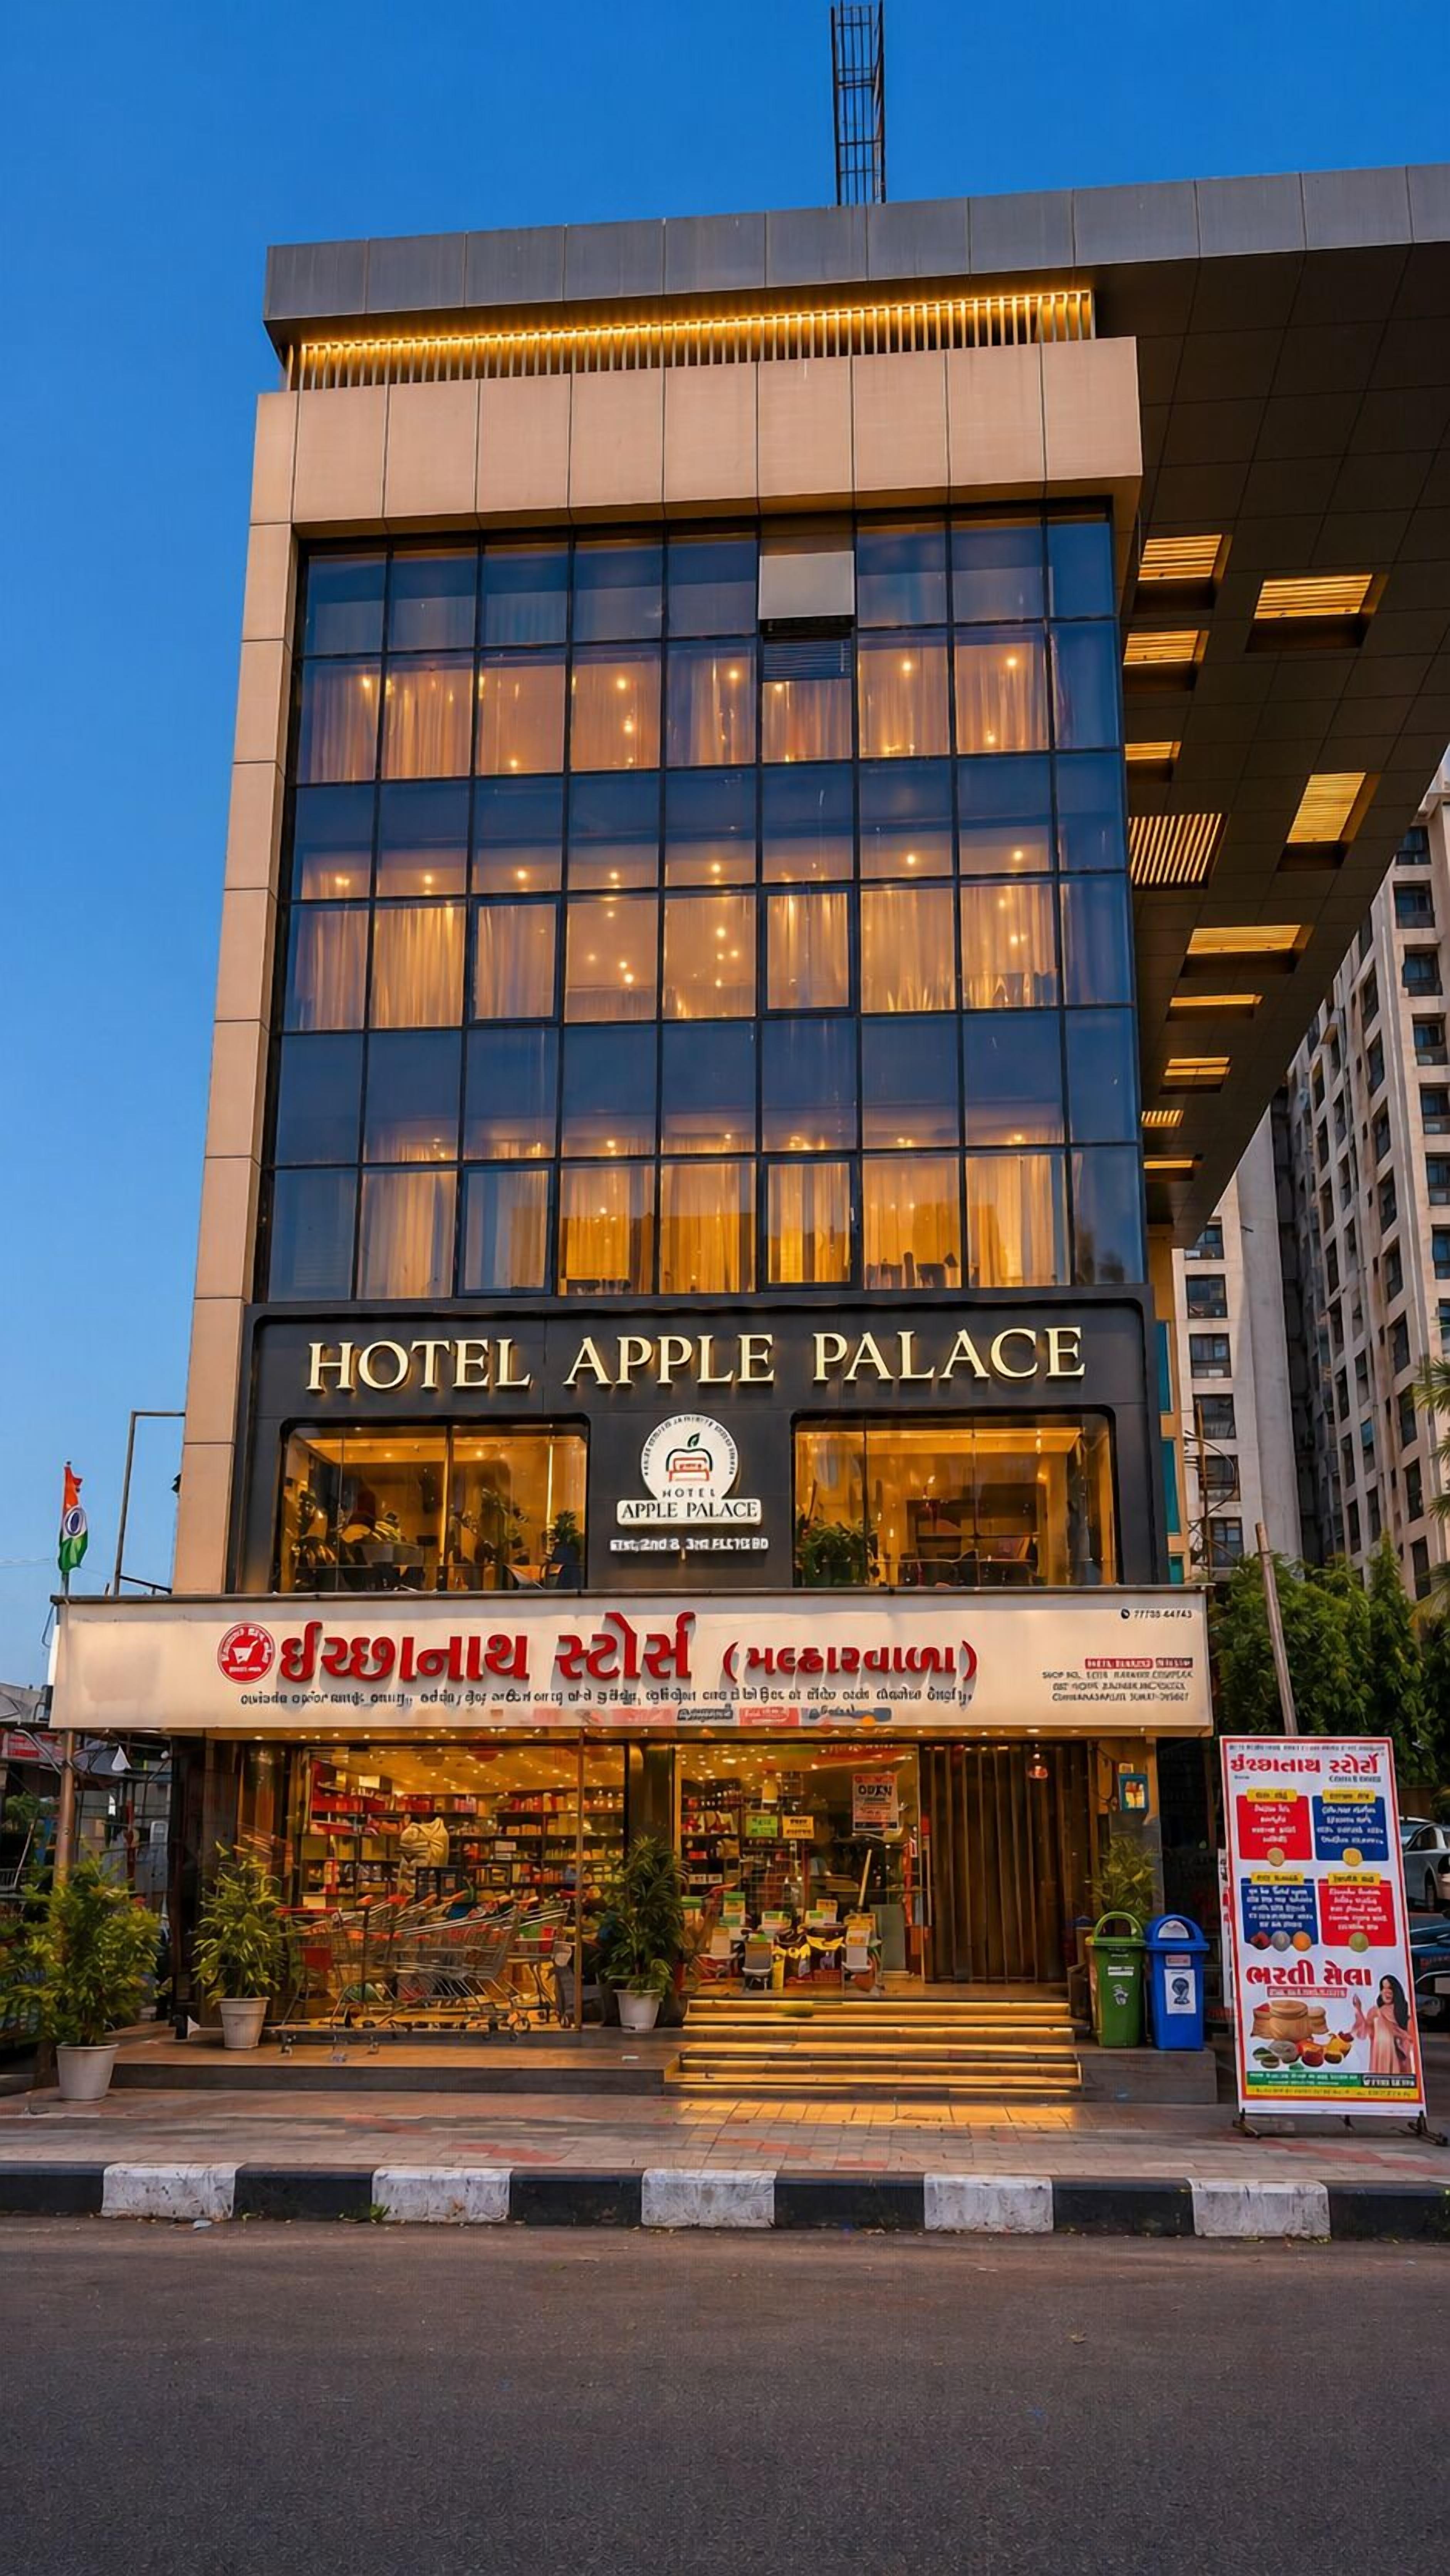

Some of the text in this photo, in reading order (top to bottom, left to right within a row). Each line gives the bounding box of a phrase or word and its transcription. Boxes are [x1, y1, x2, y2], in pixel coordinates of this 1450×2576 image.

[307, 1327, 1086, 1391] HOTEL APPLE PALACE
[662, 1488, 715, 1498] HOTEL
[622, 1502, 757, 1518] APPLE PALACE
